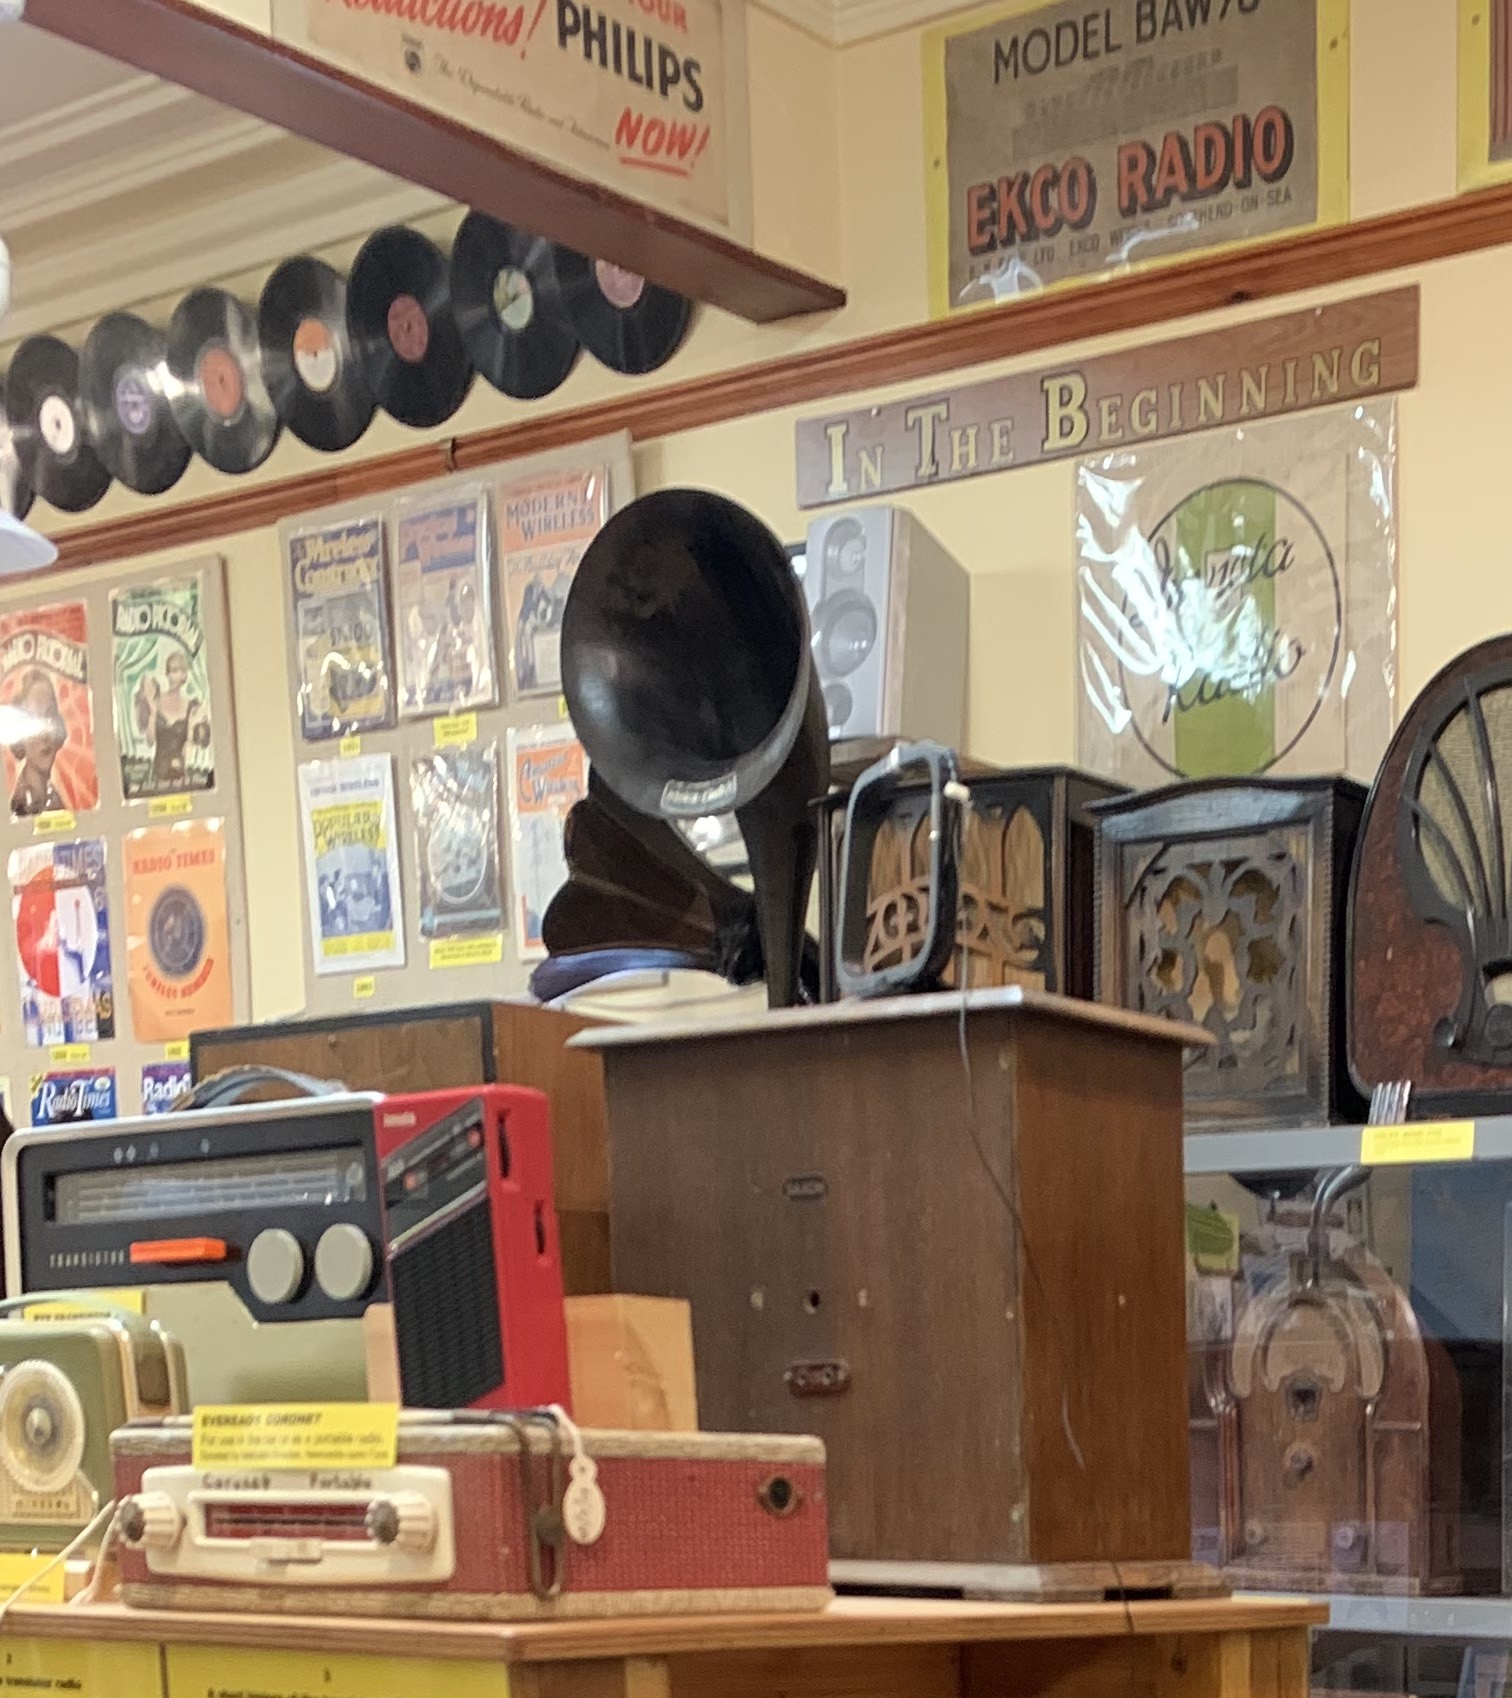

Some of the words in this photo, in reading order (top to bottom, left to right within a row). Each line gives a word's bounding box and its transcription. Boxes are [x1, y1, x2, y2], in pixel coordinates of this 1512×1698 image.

[557, 0, 704, 113] PHILIPS
[993, 9, 1122, 84] MODEL
[615, 107, 710, 168] NOW!
[966, 157, 1097, 256] EKCO
[1116, 105, 1294, 220] RADIO
[522, 508, 594, 543] WIRELESS
[133, 855, 172, 874] RADIO
